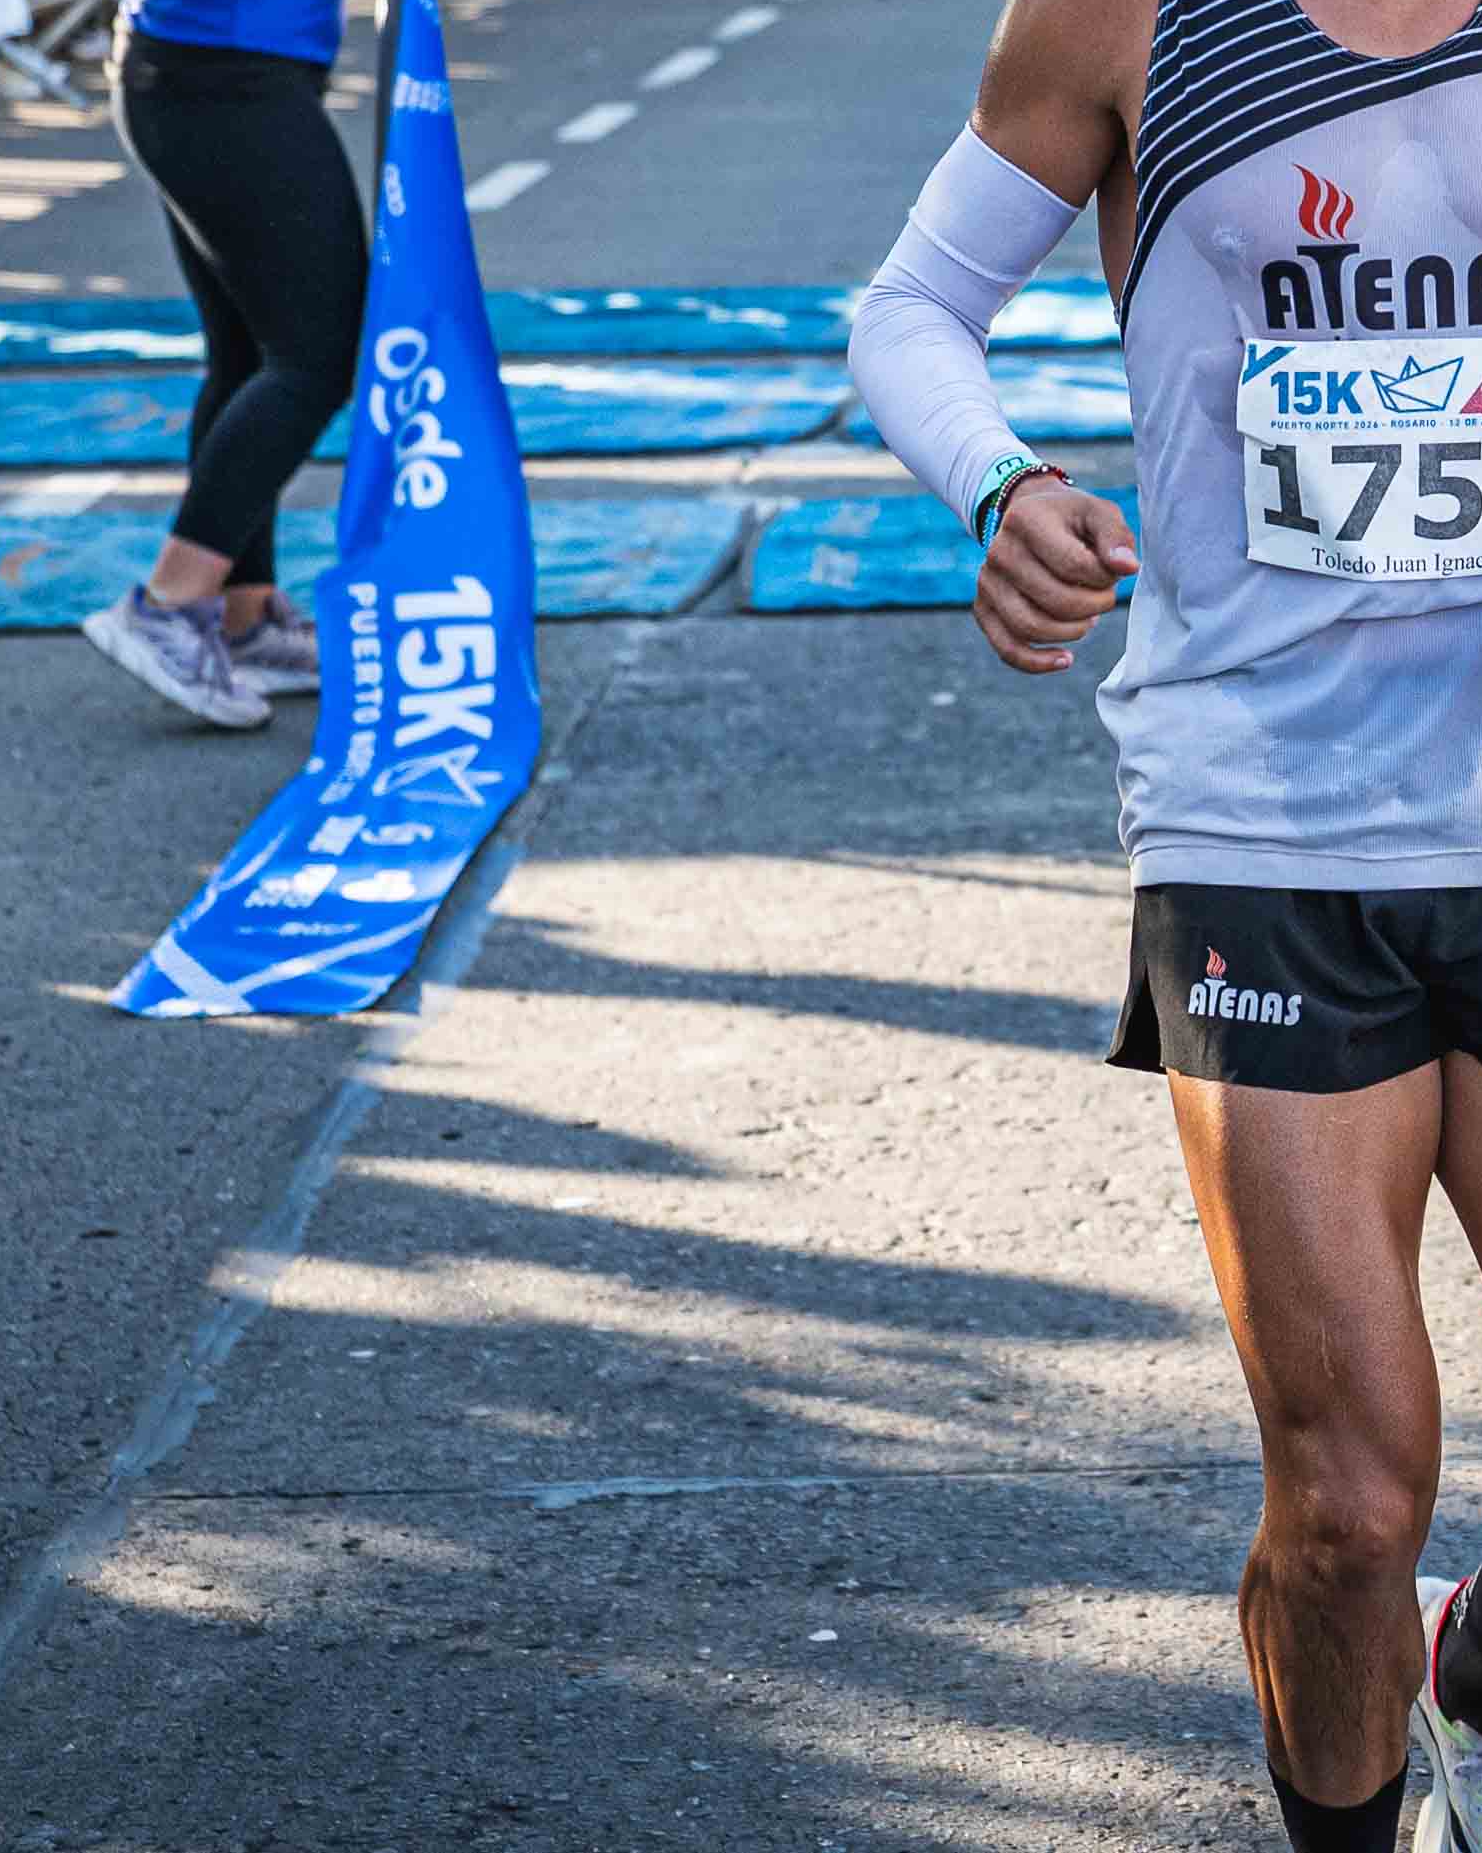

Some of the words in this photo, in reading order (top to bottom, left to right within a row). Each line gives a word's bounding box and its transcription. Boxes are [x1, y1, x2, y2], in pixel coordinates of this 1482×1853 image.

[1270, 370, 1362, 416] 15K
[369, 328, 463, 509] osde
[1271, 420, 1311, 429] PUERTO
[1315, 421, 1350, 430] NORTE
[1354, 421, 1379, 429] 2026
[1390, 418, 1436, 429] ROSARIO
[1464, 418, 1477, 427] DE
[1312, 547, 1376, 575] Toledo
[1383, 555, 1427, 573] Juan
[348, 582, 382, 725] PUERTO
[394, 575, 496, 748] 15K
[1188, 977, 1303, 1027] ATENAS
